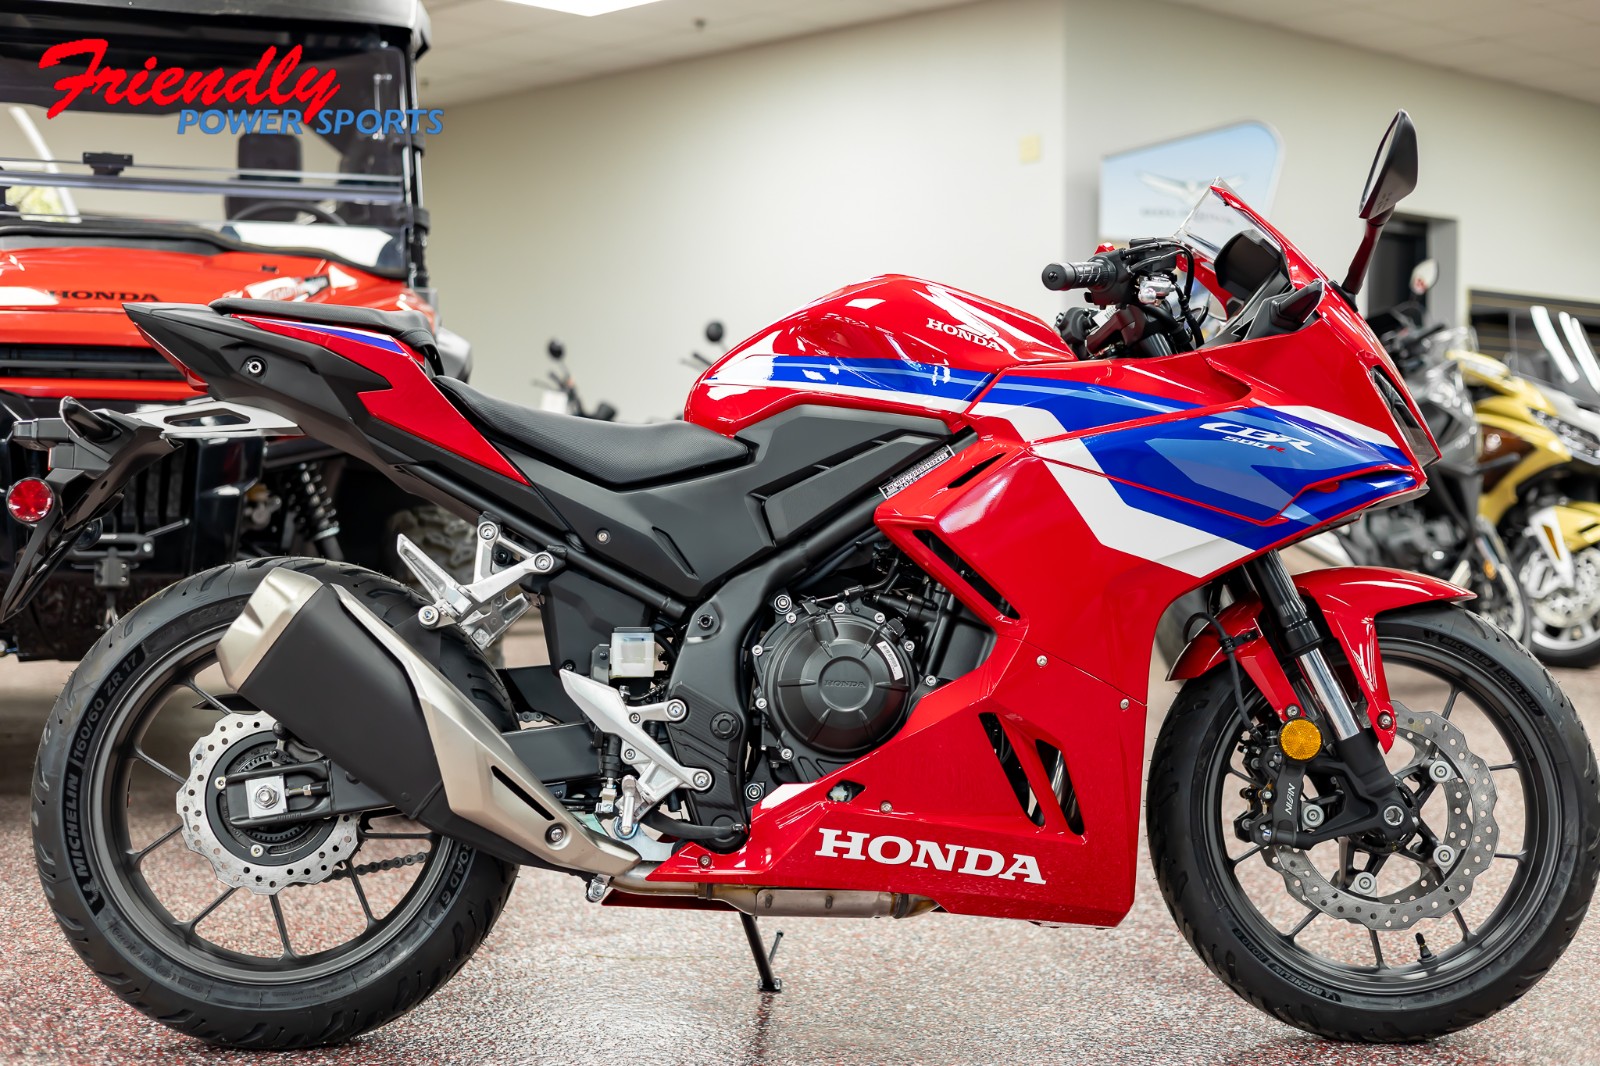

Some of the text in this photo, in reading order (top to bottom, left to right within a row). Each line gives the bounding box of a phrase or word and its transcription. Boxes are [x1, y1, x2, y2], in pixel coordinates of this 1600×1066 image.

[49, 290, 161, 302] HONDA
[926, 317, 1004, 352] HONDA
[1199, 422, 1316, 455] CBR
[1222, 435, 1287, 453] 500R
[1441, 635, 1493, 666] MICHELIN
[824, 679, 866, 688] HONDA
[65, 652, 137, 877] MICHELIN 160/60 ZR 17
[814, 827, 1047, 885] HONDA
[1272, 965, 1324, 995] MICHELIN
